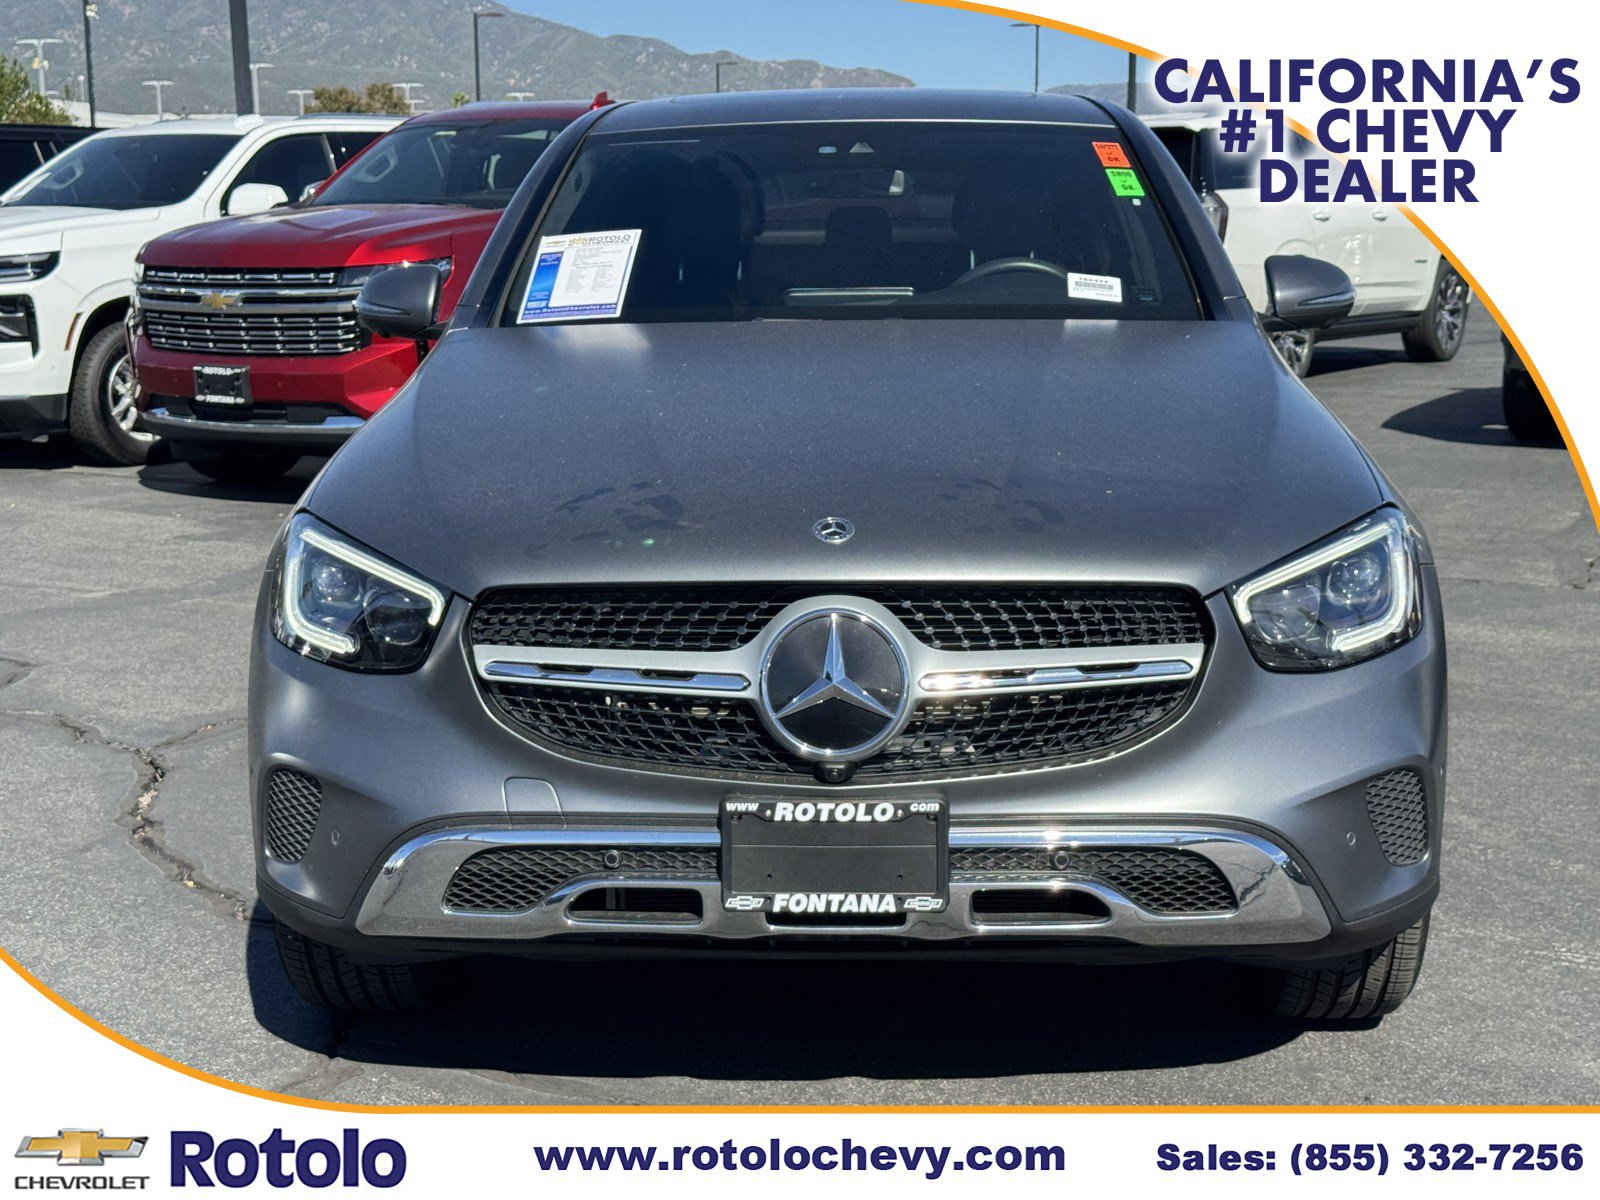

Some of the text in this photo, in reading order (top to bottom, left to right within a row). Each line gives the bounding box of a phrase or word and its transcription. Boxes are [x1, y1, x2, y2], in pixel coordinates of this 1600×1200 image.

[1121, 183, 1136, 191] OK
[589, 234, 631, 242] ROTOLO
[203, 366, 232, 375] ROTOLO
[205, 395, 236, 404] FONTANA
[725, 802, 940, 822] www ROTOLO com
[772, 893, 897, 913] FONTANA
